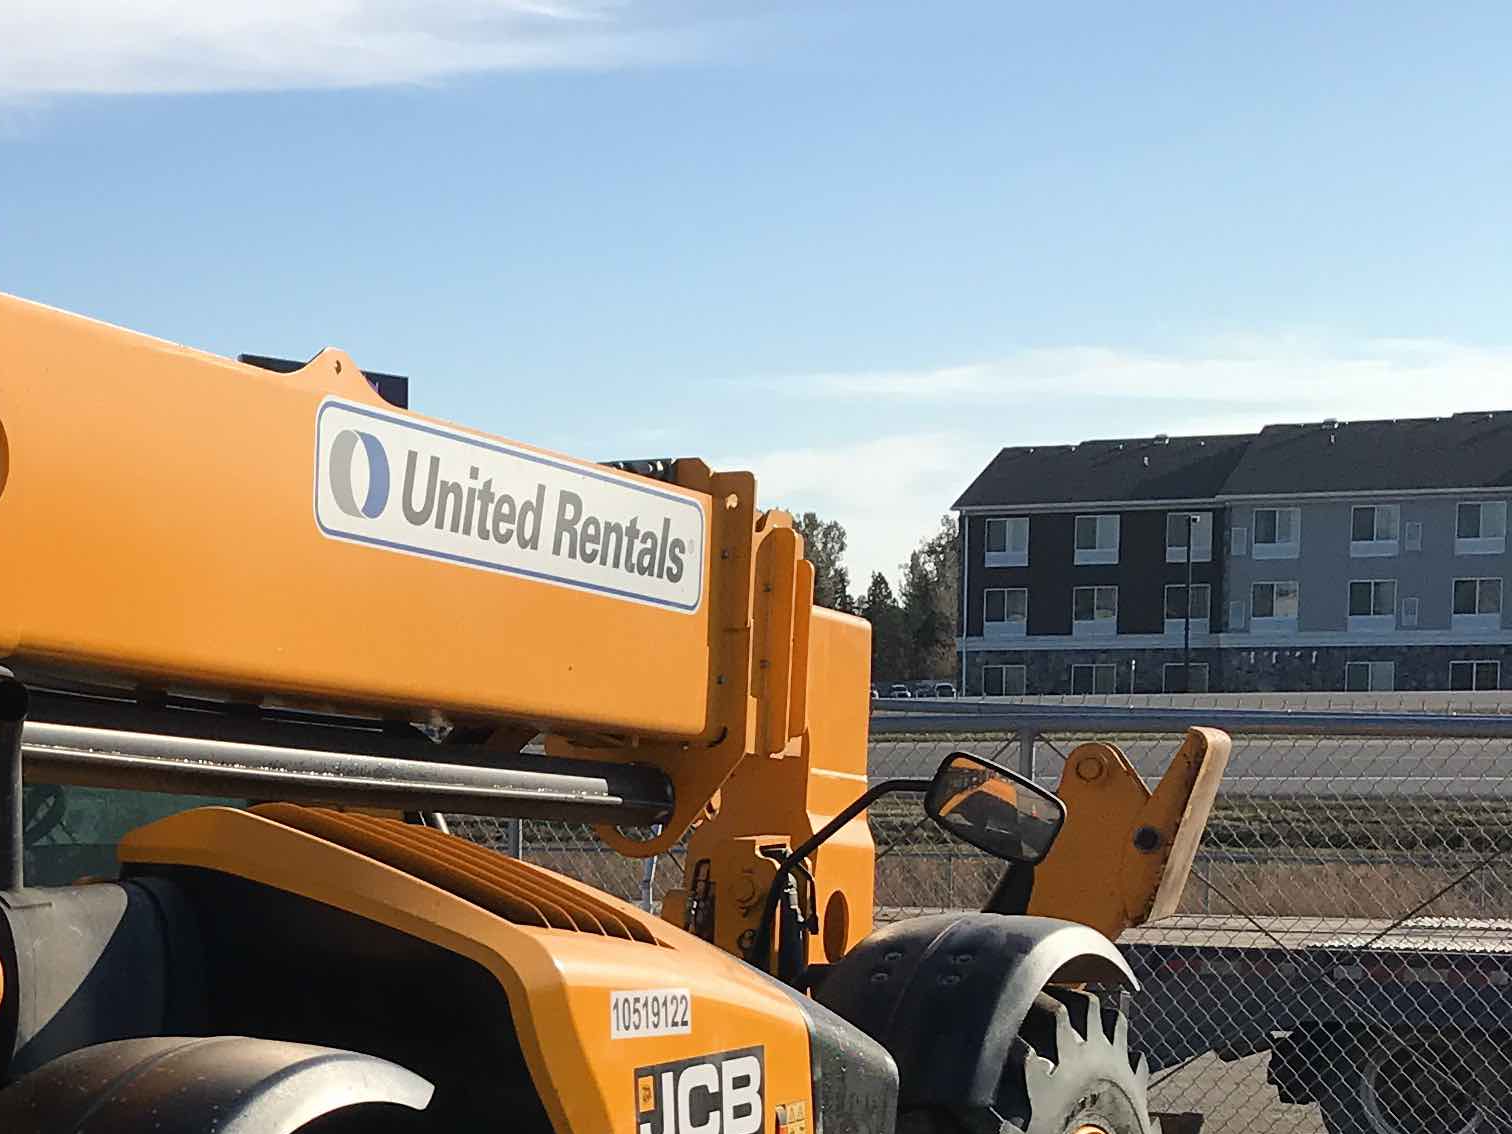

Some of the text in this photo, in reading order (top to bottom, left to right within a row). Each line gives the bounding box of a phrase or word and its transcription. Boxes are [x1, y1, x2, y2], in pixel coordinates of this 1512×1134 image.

[401, 449, 686, 584] United Rentals
[612, 993, 689, 1032] 10519122
